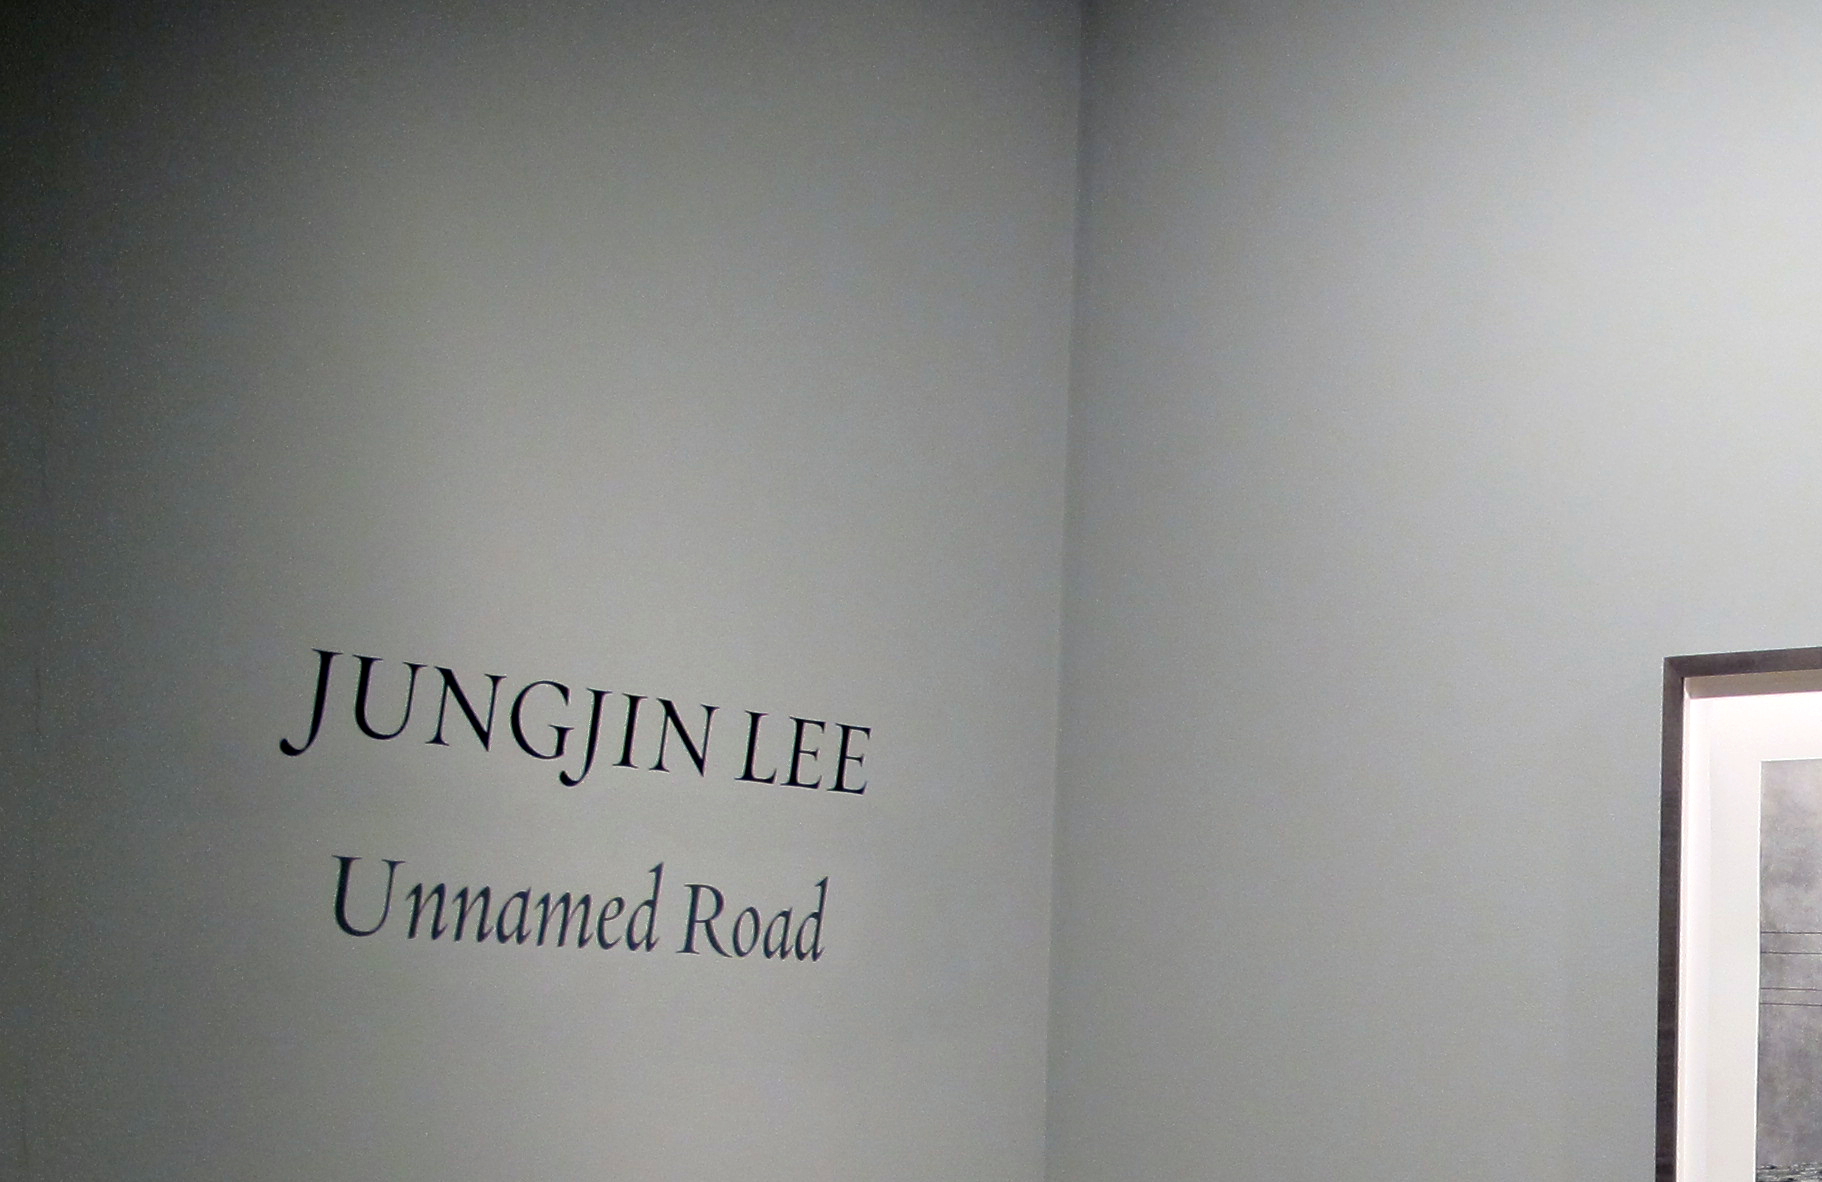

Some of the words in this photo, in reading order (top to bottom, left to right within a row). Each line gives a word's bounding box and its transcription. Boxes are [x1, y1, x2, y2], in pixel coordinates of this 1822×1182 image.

[279, 648, 720, 787] JUNGJIN
[734, 710, 872, 795] LEE
[332, 855, 664, 952] Unnamed
[676, 876, 829, 962] Road
